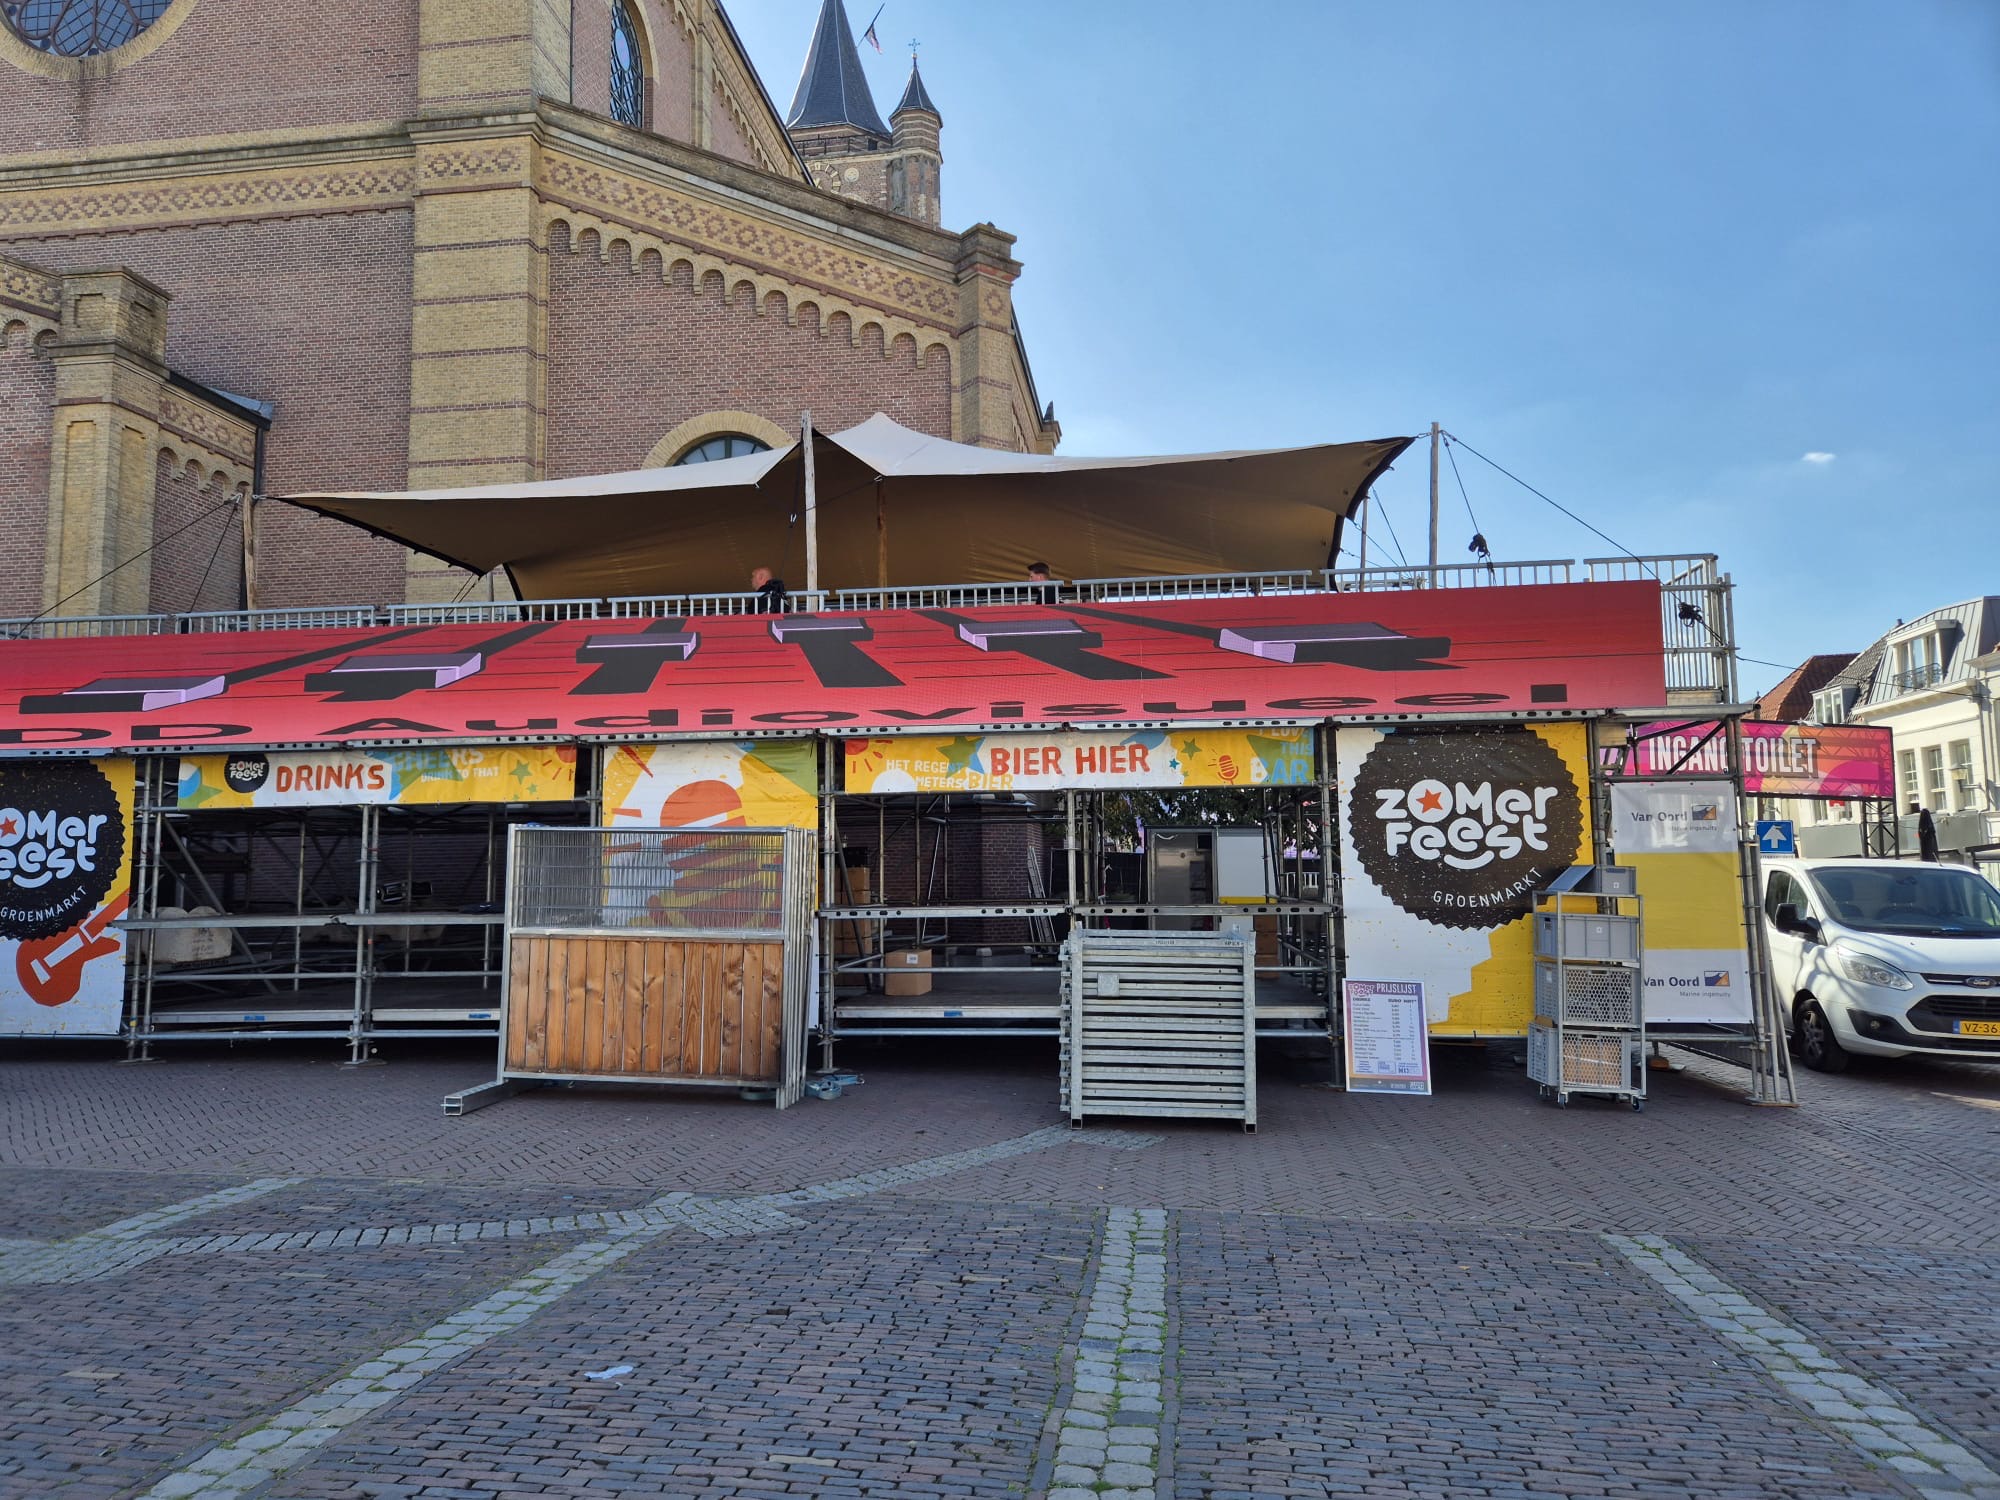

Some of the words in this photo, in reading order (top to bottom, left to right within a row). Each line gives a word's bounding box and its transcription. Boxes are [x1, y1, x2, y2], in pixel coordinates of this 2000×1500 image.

[315, 683, 1568, 738] Audiovisueel
[1281, 741, 1314, 756] THIS
[1742, 737, 1817, 773] TOILET
[886, 760, 911, 771] HET
[914, 760, 964, 774] REGENT
[990, 746, 1062, 776] BIER
[1075, 744, 1151, 774] HIER
[276, 763, 385, 793] DRINKS
[473, 767, 499, 777] THAT
[1250, 757, 1310, 785] BAR
[916, 775, 964, 789] METERS
[967, 773, 1014, 790] BIER
[1631, 811, 1654, 823] Van
[1433, 866, 1542, 908] GROENMARKT
[0, 885, 87, 922] GROENMARKT
[1376, 983, 1417, 994] PRIJSLIJST
[1644, 977, 1665, 987] Van
[1669, 976, 1700, 987] Oord
[1964, 1023, 2000, 1034] VZ-36
